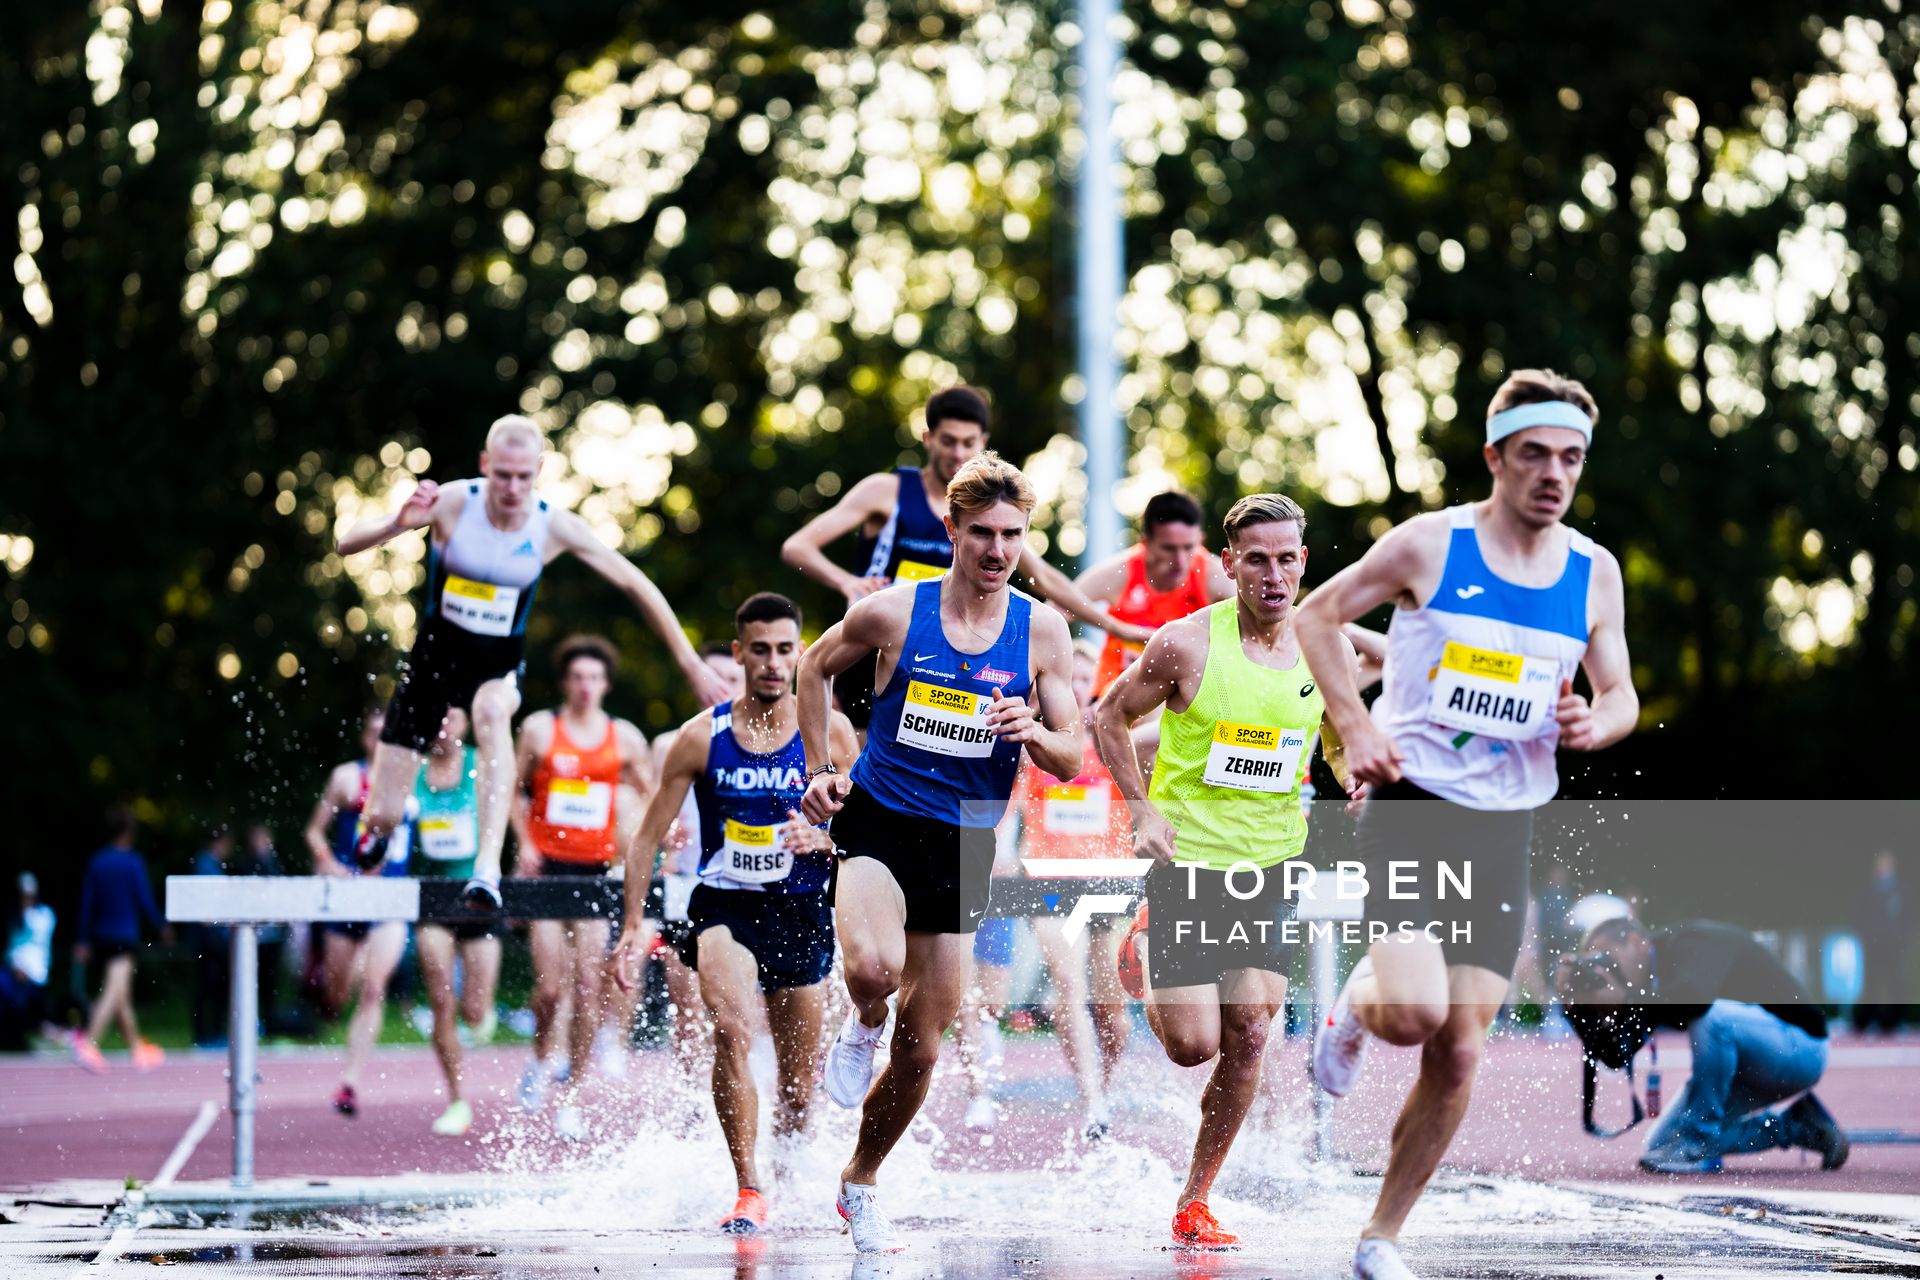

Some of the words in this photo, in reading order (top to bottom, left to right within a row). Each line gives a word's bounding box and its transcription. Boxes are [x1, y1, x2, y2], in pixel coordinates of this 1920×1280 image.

[929, 698, 969, 711] VLAANDEREN
[1448, 686, 1531, 724] AIRIAU
[903, 713, 993, 744] SCHNEIDER
[1235, 737, 1273, 747] VLAANDEREN
[1281, 736, 1303, 749] ifam
[736, 767, 804, 790] DMA
[733, 850, 784, 871] BRESC
